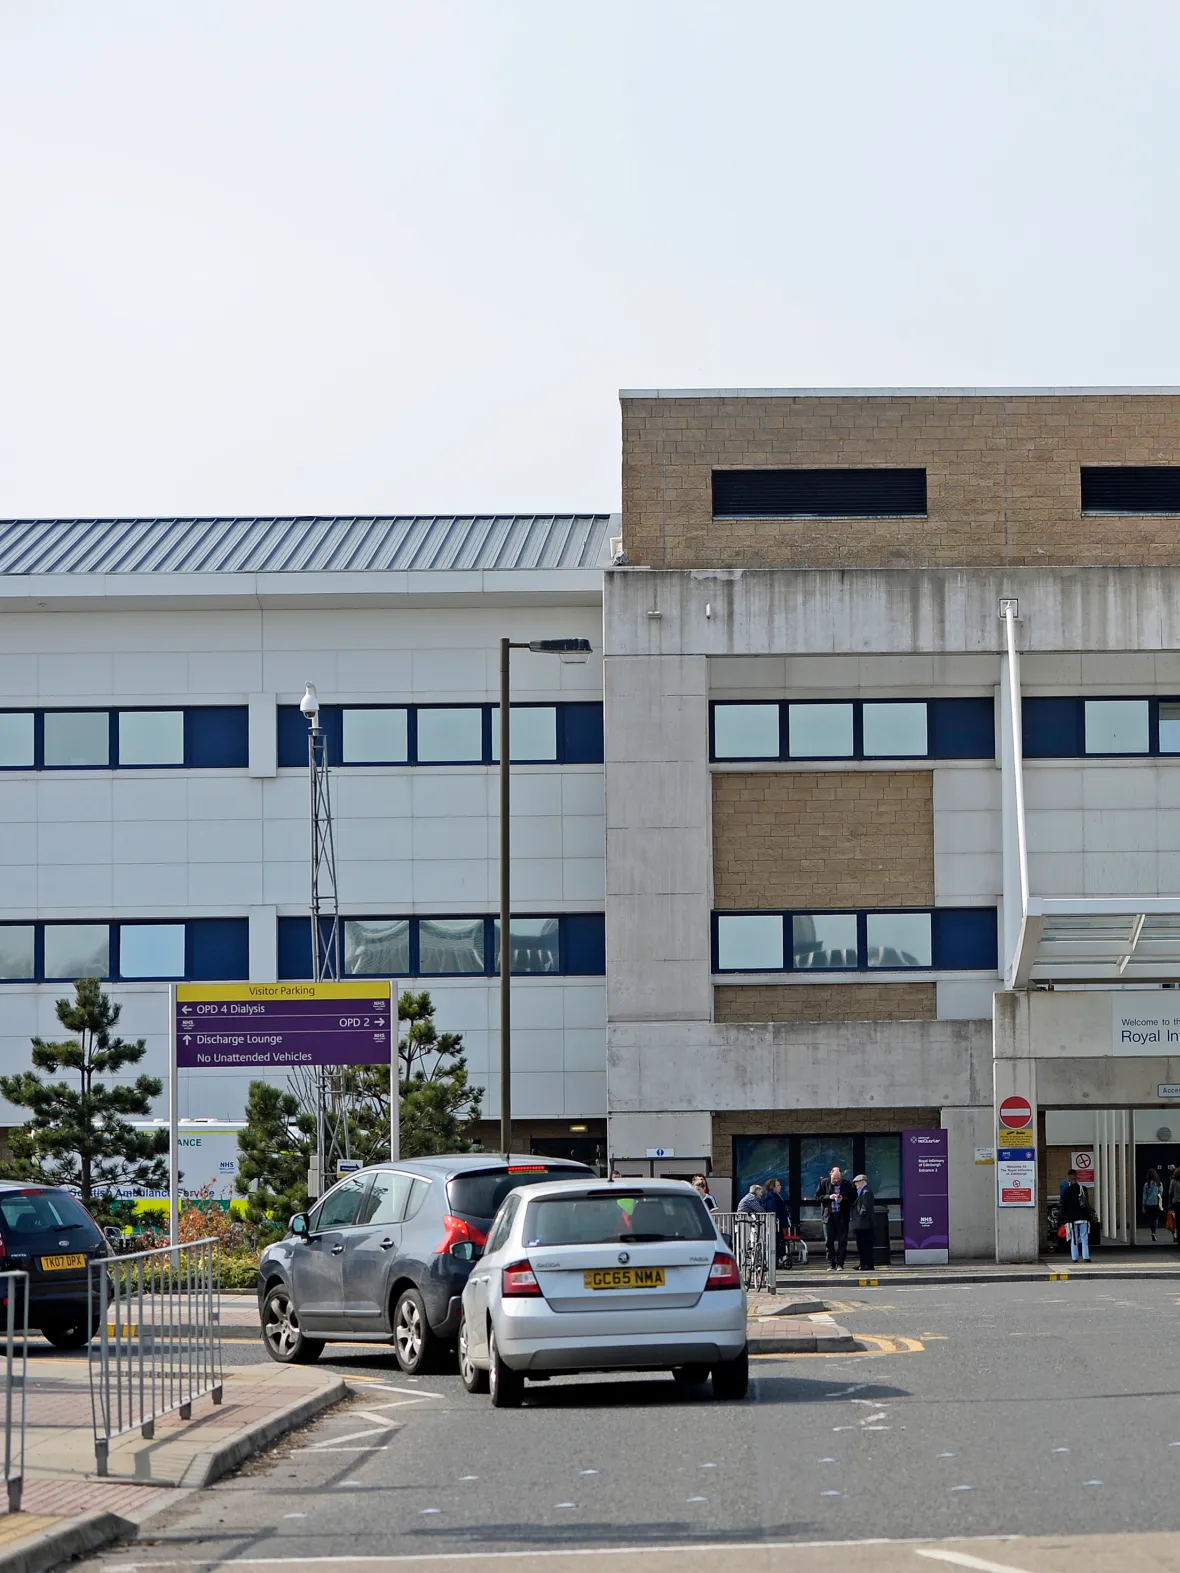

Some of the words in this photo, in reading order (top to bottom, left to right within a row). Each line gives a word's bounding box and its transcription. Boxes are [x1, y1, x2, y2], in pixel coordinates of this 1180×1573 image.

[249, 987, 278, 996] Visitor
[280, 986, 315, 996] Parking
[196, 1004, 218, 1014] OPD
[220, 1004, 228, 1013] 4
[230, 1004, 266, 1015] Dialysis
[339, 1018, 360, 1027] OPD
[363, 1018, 370, 1026] 2
[196, 1034, 244, 1046] Discharge
[247, 1034, 282, 1045] Lounge
[1121, 1030, 1160, 1044] Royal
[197, 1054, 211, 1062] No
[214, 1052, 270, 1062] Unattended
[272, 1052, 312, 1061] Vehicles
[44, 1256, 64, 1268] TK07
[67, 1255, 82, 1266] DPX
[592, 1271, 631, 1286] GC65
[635, 1270, 662, 1284] NMA
